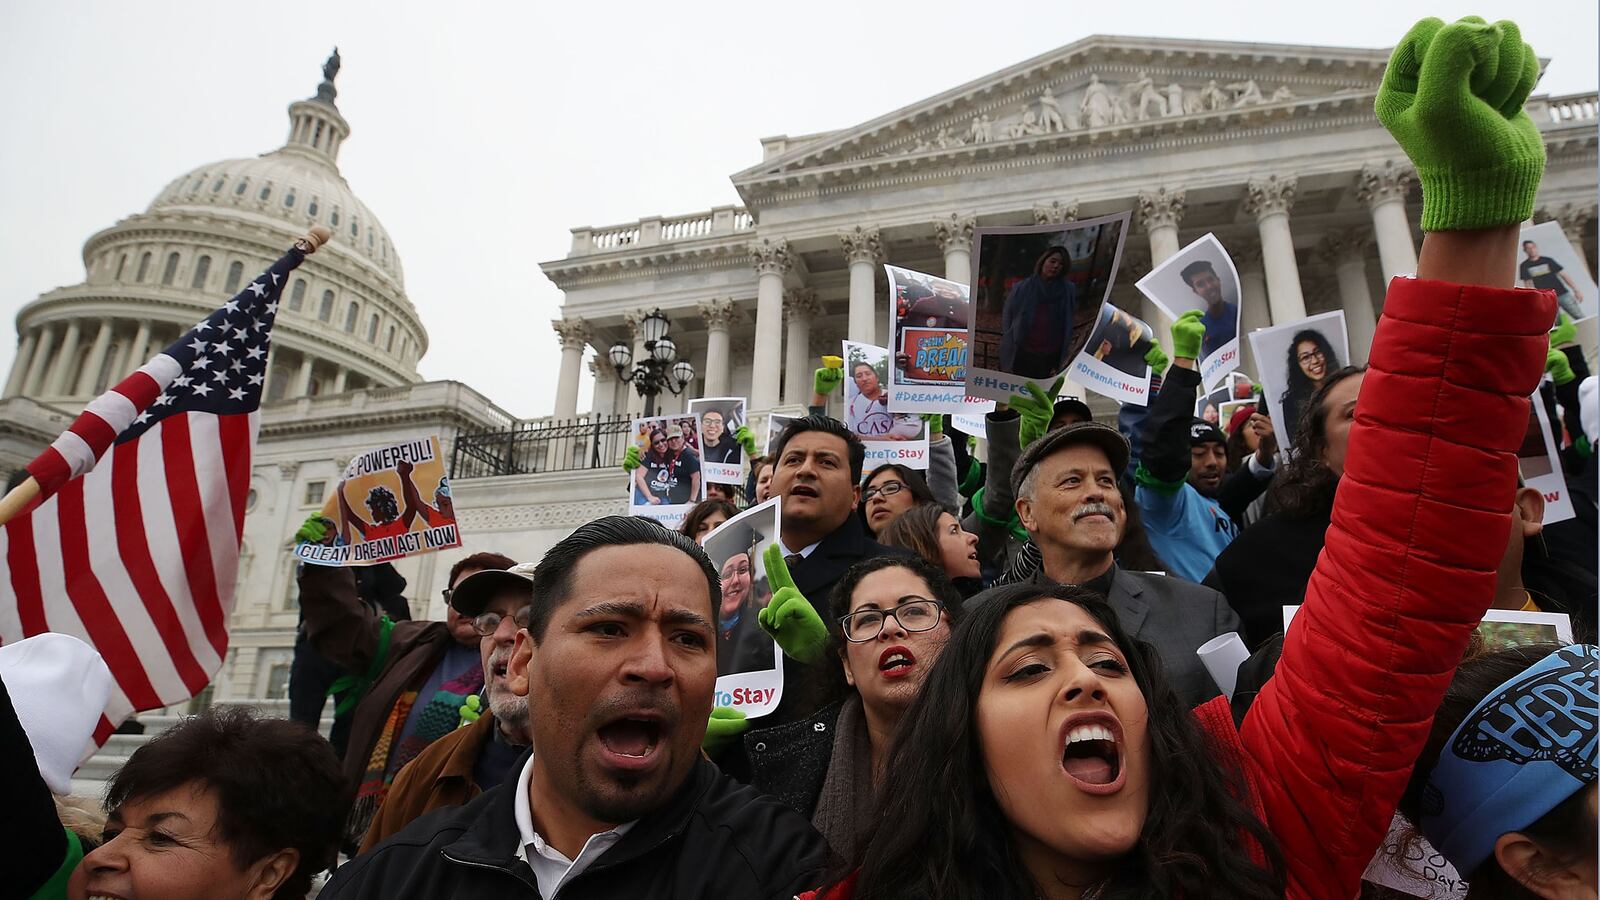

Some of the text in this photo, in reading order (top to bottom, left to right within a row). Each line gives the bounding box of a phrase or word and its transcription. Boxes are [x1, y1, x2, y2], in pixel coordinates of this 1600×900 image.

[358, 439, 433, 475] POWERFUL!
[863, 449, 924, 460] ereToStay
[300, 525, 456, 562] CLEAN DREAM ACT NOW
[1423, 866, 1468, 892] Days
